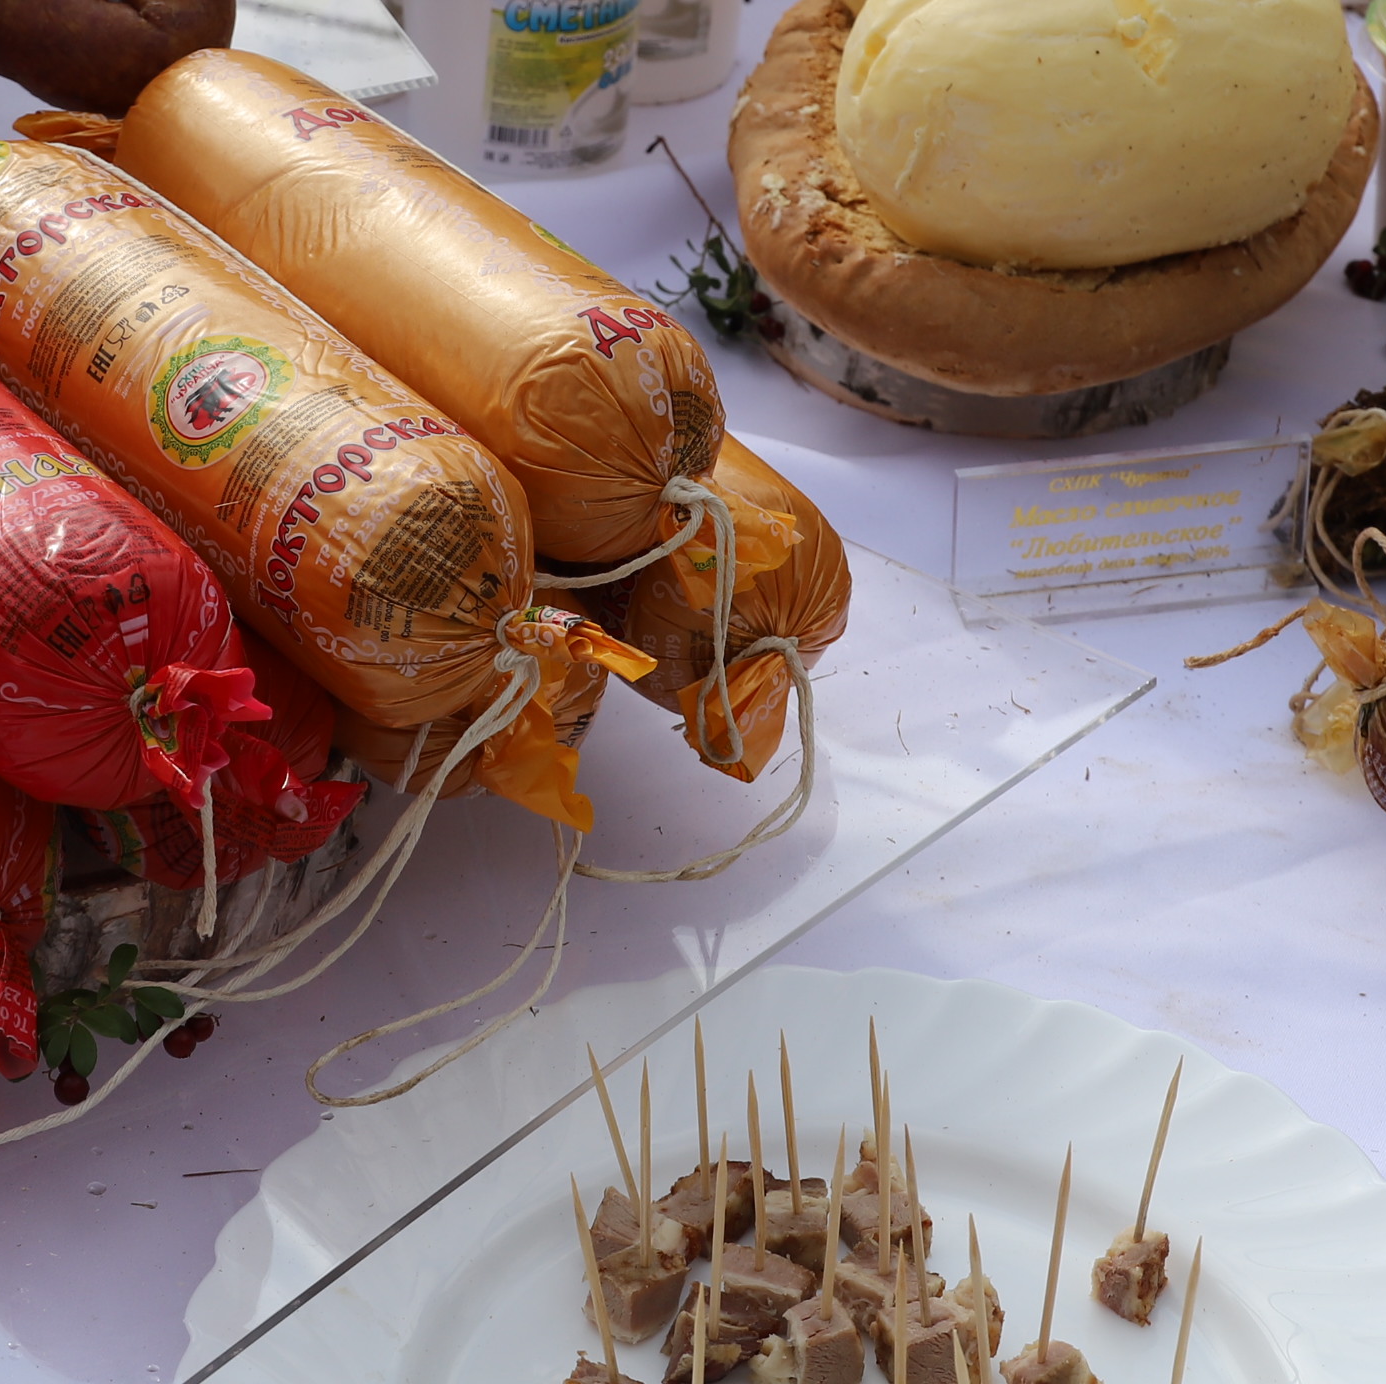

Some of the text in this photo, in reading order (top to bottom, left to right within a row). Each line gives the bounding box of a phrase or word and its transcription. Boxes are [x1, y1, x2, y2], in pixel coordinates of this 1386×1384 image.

[19, 297, 49, 338] ГОСТ
[174, 361, 206, 390] СХПК
[1009, 489, 1243, 530] Масло сливочное
[314, 543, 335, 568] ТР
[327, 517, 351, 542] ТС
[328, 546, 358, 587] ГОСТ
